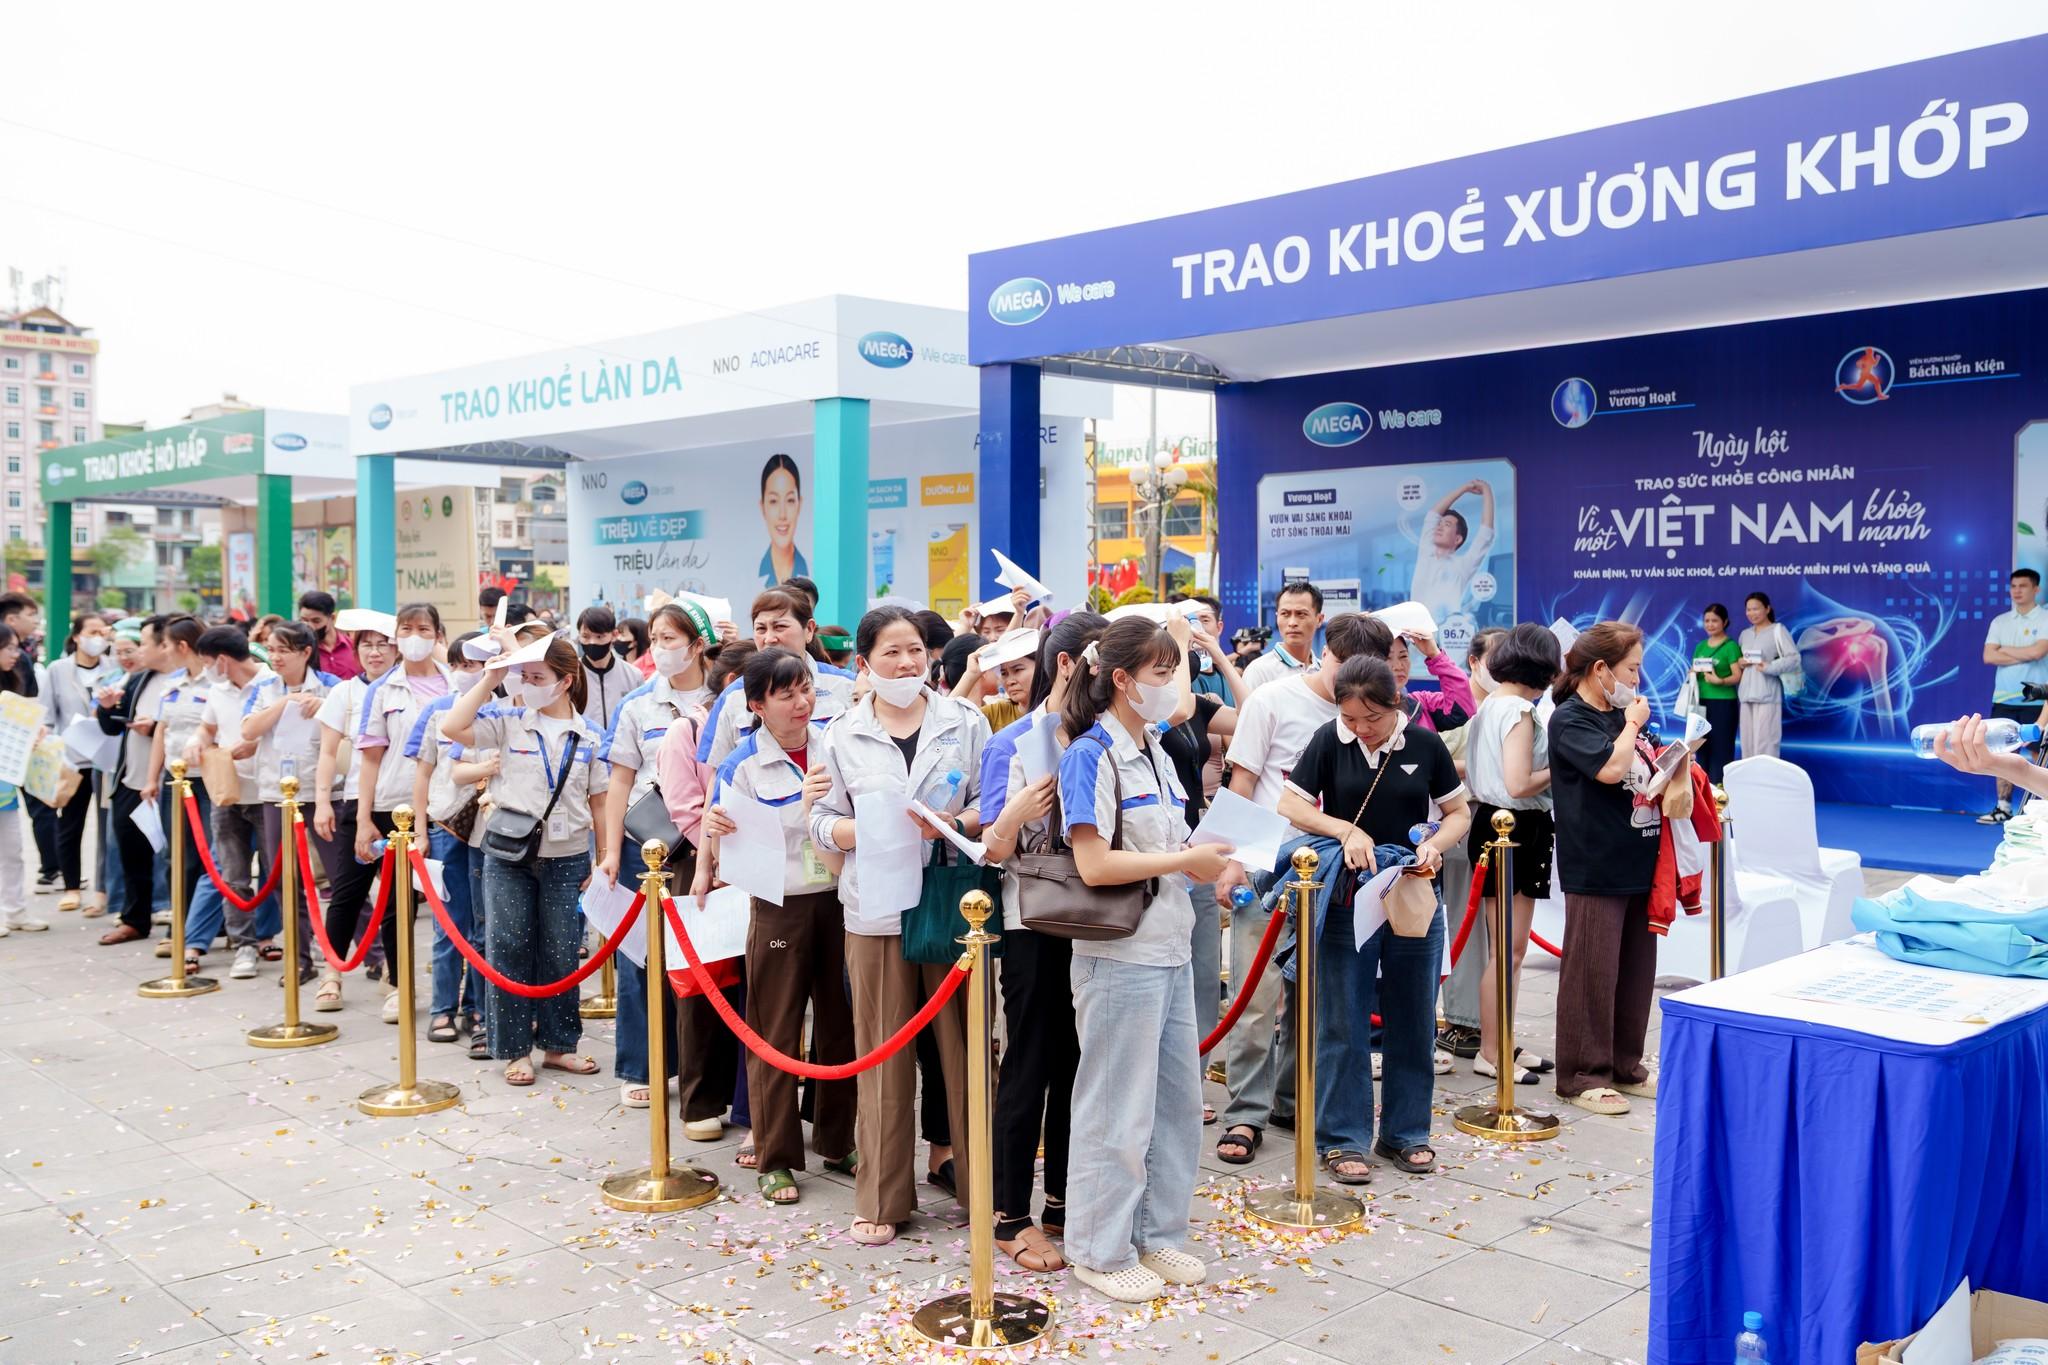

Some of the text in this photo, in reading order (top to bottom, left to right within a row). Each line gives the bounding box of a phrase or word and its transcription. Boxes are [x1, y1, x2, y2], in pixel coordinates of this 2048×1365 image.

[1172, 98, 2030, 299] TRAO KHOẺ XƯƠNG KHỚP
[996, 280, 1115, 313] MEGA We care
[713, 341, 820, 375] NNO ACNACARE
[863, 340, 967, 365] MEGA We care
[1908, 358, 2006, 379] Bách Niên Kiện
[441, 356, 683, 424] TRAO KHOẺ LÀN DA
[1608, 391, 1677, 408] Vương Hoạt
[1311, 408, 1442, 435] MEGA We care
[83, 455, 117, 483] TRAO
[118, 440, 154, 479] KHOẺ
[177, 429, 208, 470] HẤP
[1692, 426, 1790, 468] Ngày hội
[582, 472, 608, 491] NNO
[1635, 464, 1855, 491] TRAO SỨC KHỎE CÔNG NHÂN
[600, 515, 688, 544] TRIỆU VẺ ĐẸP
[1574, 505, 1617, 558] Vì một
[1610, 493, 1853, 560] VIỆT NAM
[1858, 488, 1932, 548] khỏe mạnh
[614, 539, 710, 576] TRIỆU làn da
[1574, 568, 1601, 579] KHÁM
[1602, 567, 1628, 580] BỆNH,
[1631, 568, 1643, 578] TƯ
[1644, 567, 1665, 578] VẤN
[1666, 566, 1685, 577] SỨC
[1718, 564, 1737, 577] CẤP
[1739, 563, 1764, 576] PHÁT
[1767, 562, 1801, 576] THUỐC
[1803, 562, 1830, 575] MIỄN
[1832, 562, 1850, 575] PHÍ
[1853, 562, 1869, 574] VÀ
[1871, 562, 1902, 576] TẶNG
[1905, 560, 1931, 574] QUÀ
[408, 569, 439, 590] NAM
